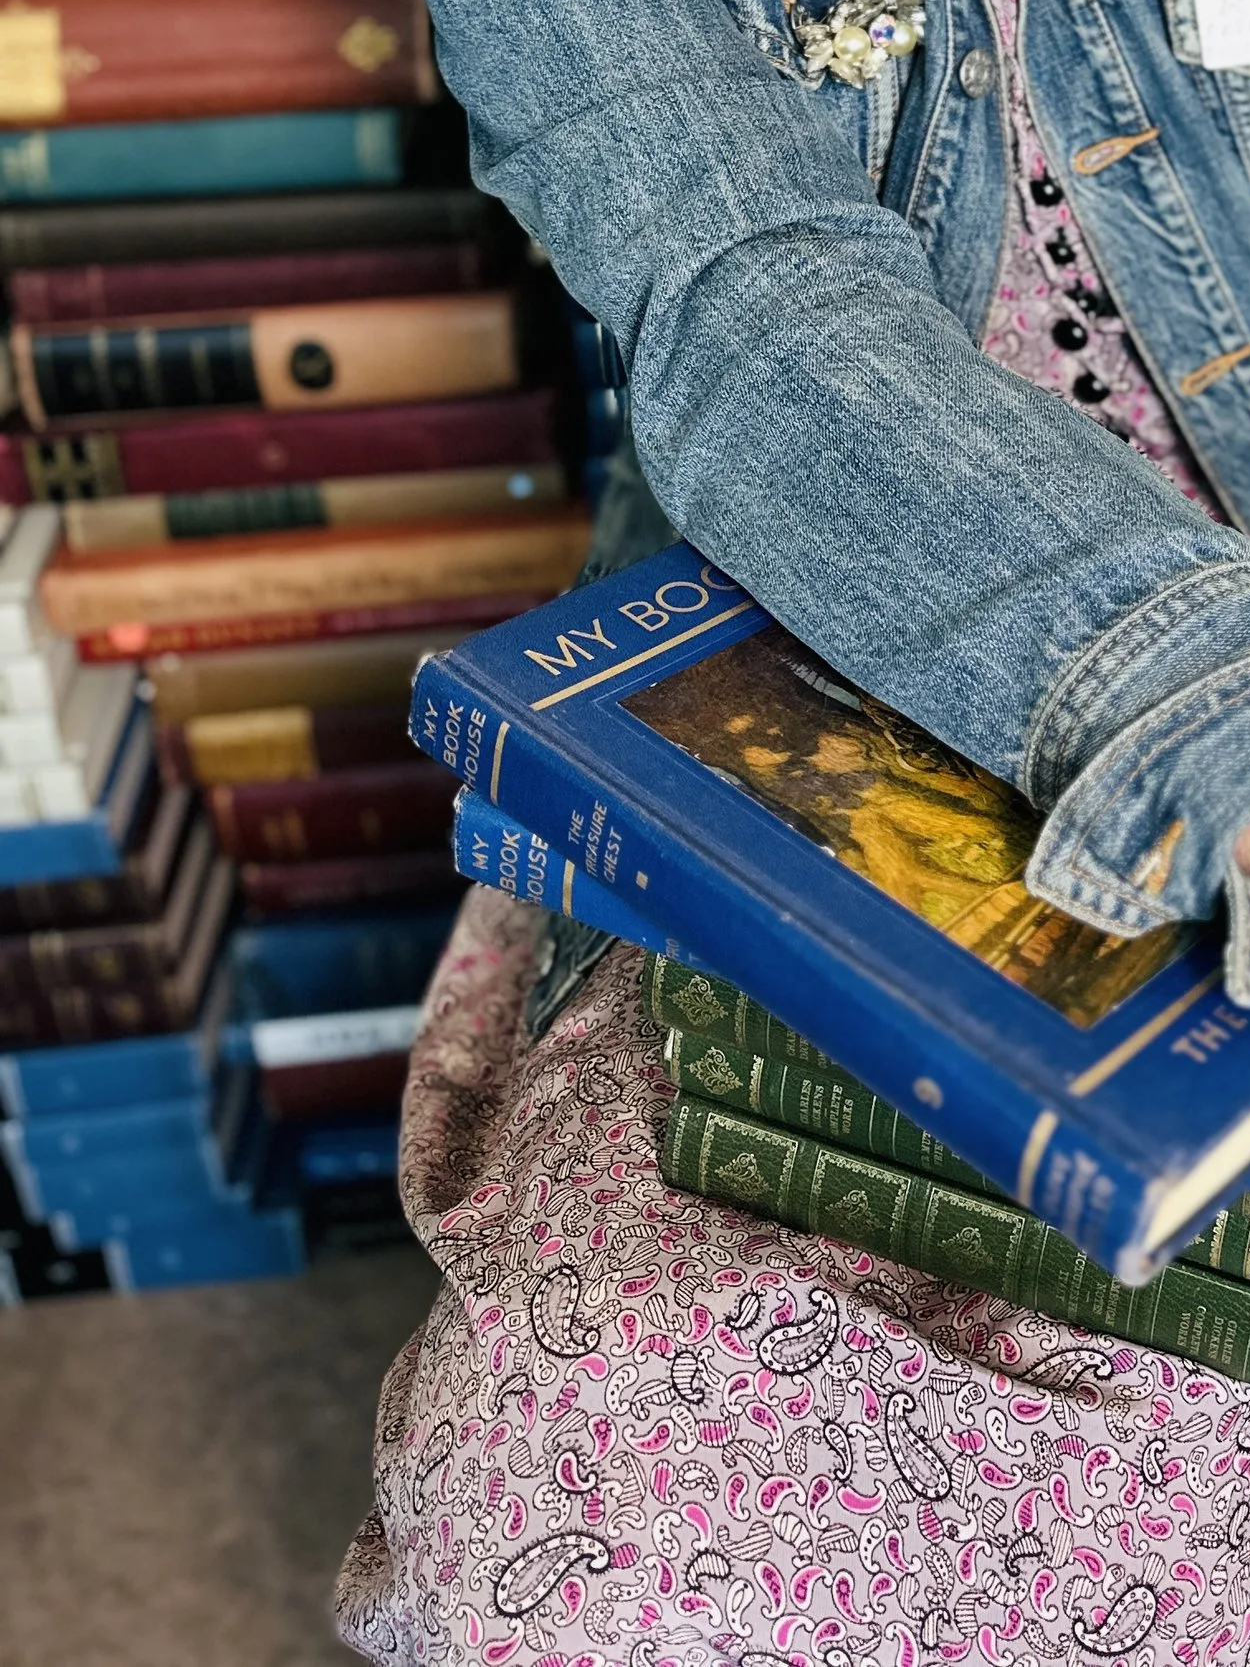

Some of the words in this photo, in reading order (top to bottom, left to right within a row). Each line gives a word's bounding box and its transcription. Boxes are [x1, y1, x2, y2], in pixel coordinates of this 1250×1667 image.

[523, 618, 617, 676] MY
[618, 564, 743, 632] BOO
[423, 698, 439, 743] MY
[443, 699, 464, 769] BOOK
[463, 707, 487, 790] HOUSE
[472, 832, 490, 870] MY
[568, 809, 585, 845] THE
[585, 799, 608, 878] TREASURE
[603, 826, 623, 884] CHEST
[499, 828, 522, 894] BOOK
[1170, 1004, 1248, 1063] THE
[842, 1098, 854, 1134] WORKS
[1070, 1250, 1087, 1306] ICTURES
[1176, 1312, 1191, 1347] WORKS
[1222, 1320, 1238, 1364] CHARLES
